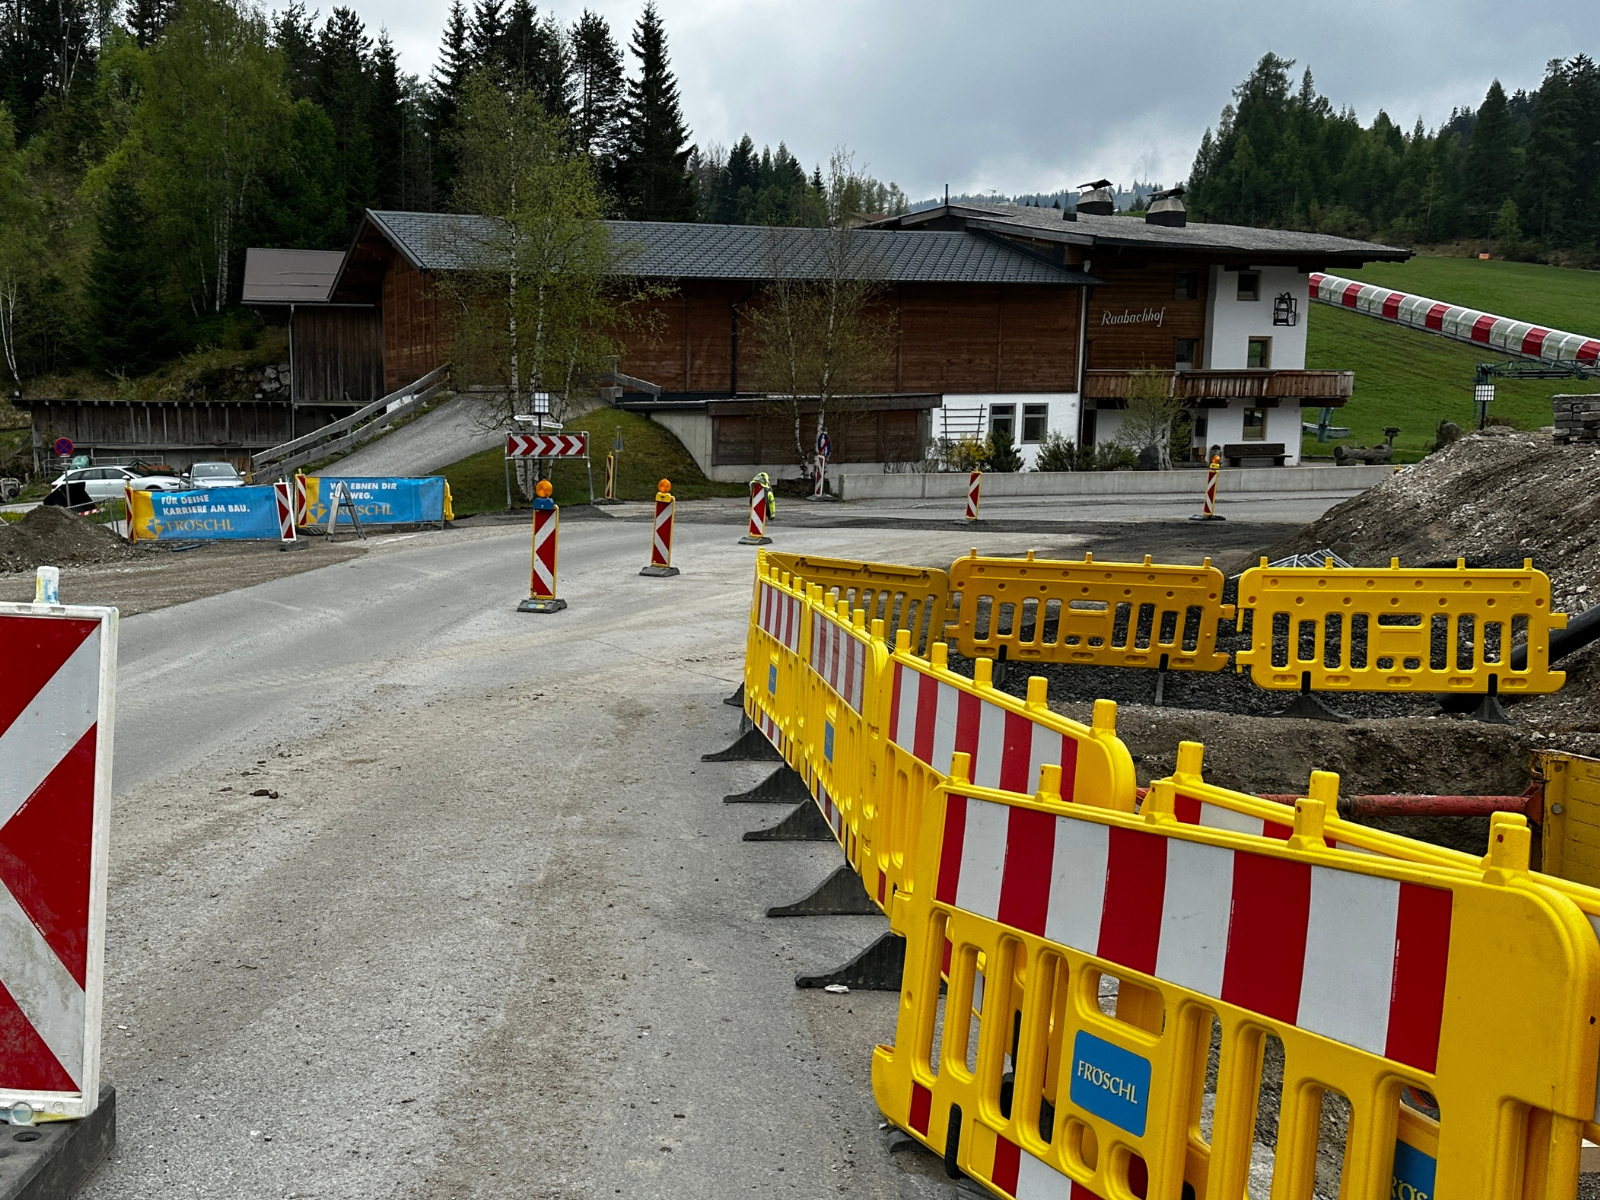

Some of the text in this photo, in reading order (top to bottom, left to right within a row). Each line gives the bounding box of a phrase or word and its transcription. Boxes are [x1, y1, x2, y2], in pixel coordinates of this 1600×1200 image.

[1100, 306, 1166, 328] Raabachhof
[161, 495, 209, 505] FÜR DEINE
[350, 492, 374, 500] WEG.
[163, 504, 250, 515] KARRIERE AM BAU.
[1077, 1059, 1138, 1104] FRÖSCHL
